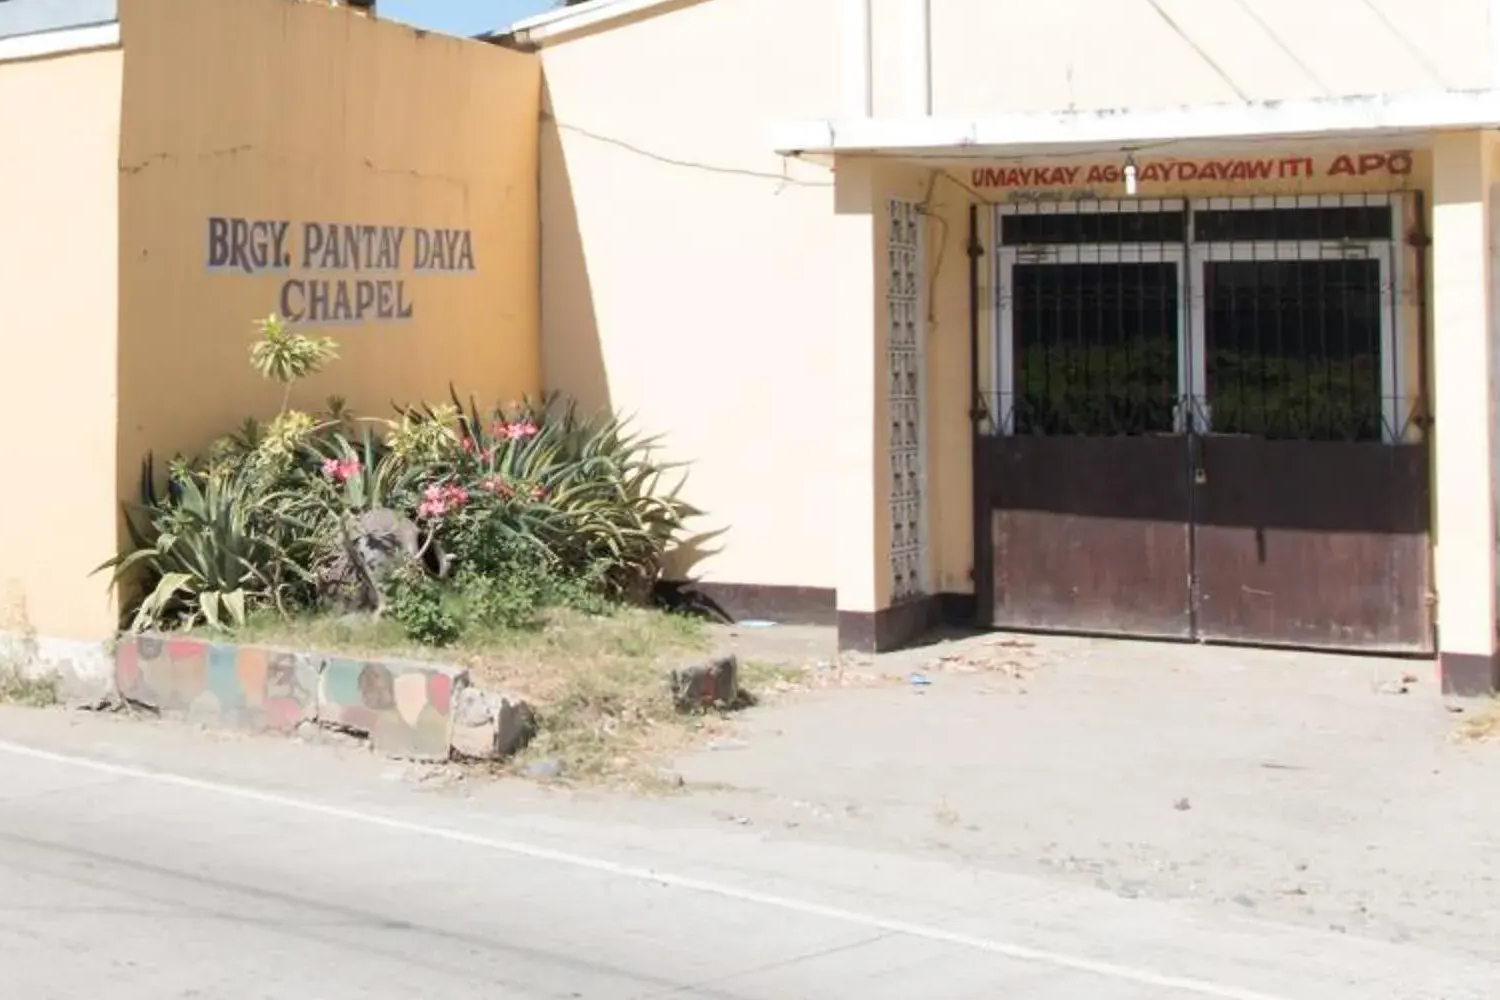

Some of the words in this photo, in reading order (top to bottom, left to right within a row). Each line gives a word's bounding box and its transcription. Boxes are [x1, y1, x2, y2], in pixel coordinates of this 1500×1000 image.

[971, 166, 1080, 188] UMAYKAY
[1086, 160, 1273, 183] AGAYDAYAW
[1279, 156, 1314, 179] ITI
[1327, 151, 1413, 177] APO
[207, 217, 290, 273] BRGY.
[302, 222, 404, 271] PANTAY
[414, 227, 475, 271] DAYA
[280, 278, 413, 323] CHAPEL
